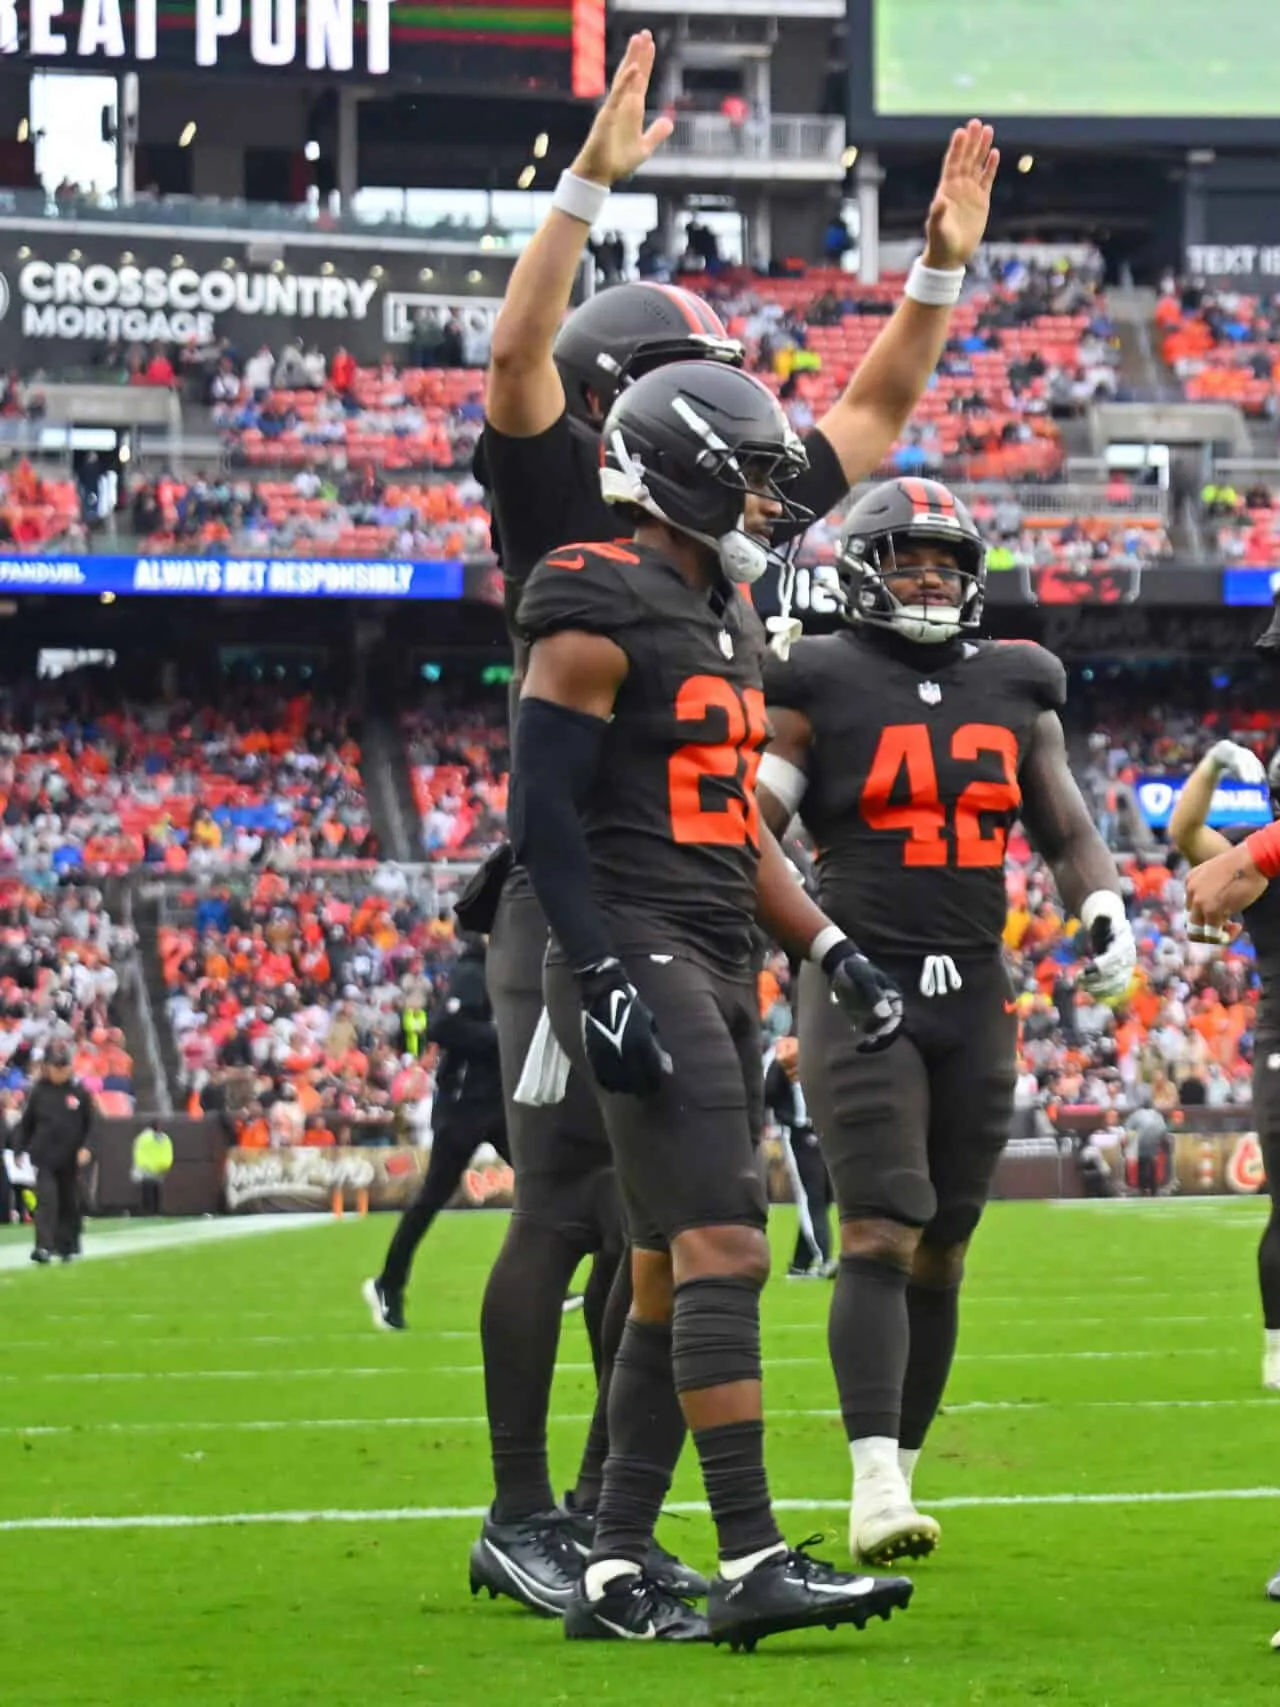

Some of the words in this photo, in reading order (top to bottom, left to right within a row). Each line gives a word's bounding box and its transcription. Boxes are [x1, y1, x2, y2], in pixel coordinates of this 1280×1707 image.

[196, 0, 390, 74] PUNT
[1187, 246, 1257, 274] TEXT
[18, 261, 378, 320] CROSSCOUNTRY
[22, 304, 215, 343] MORTGAGE
[133, 559, 222, 590] ALWAYS
[223, 561, 267, 591] BET
[268, 562, 415, 594] RESPONSIBLY
[858, 723, 1022, 868] 42
